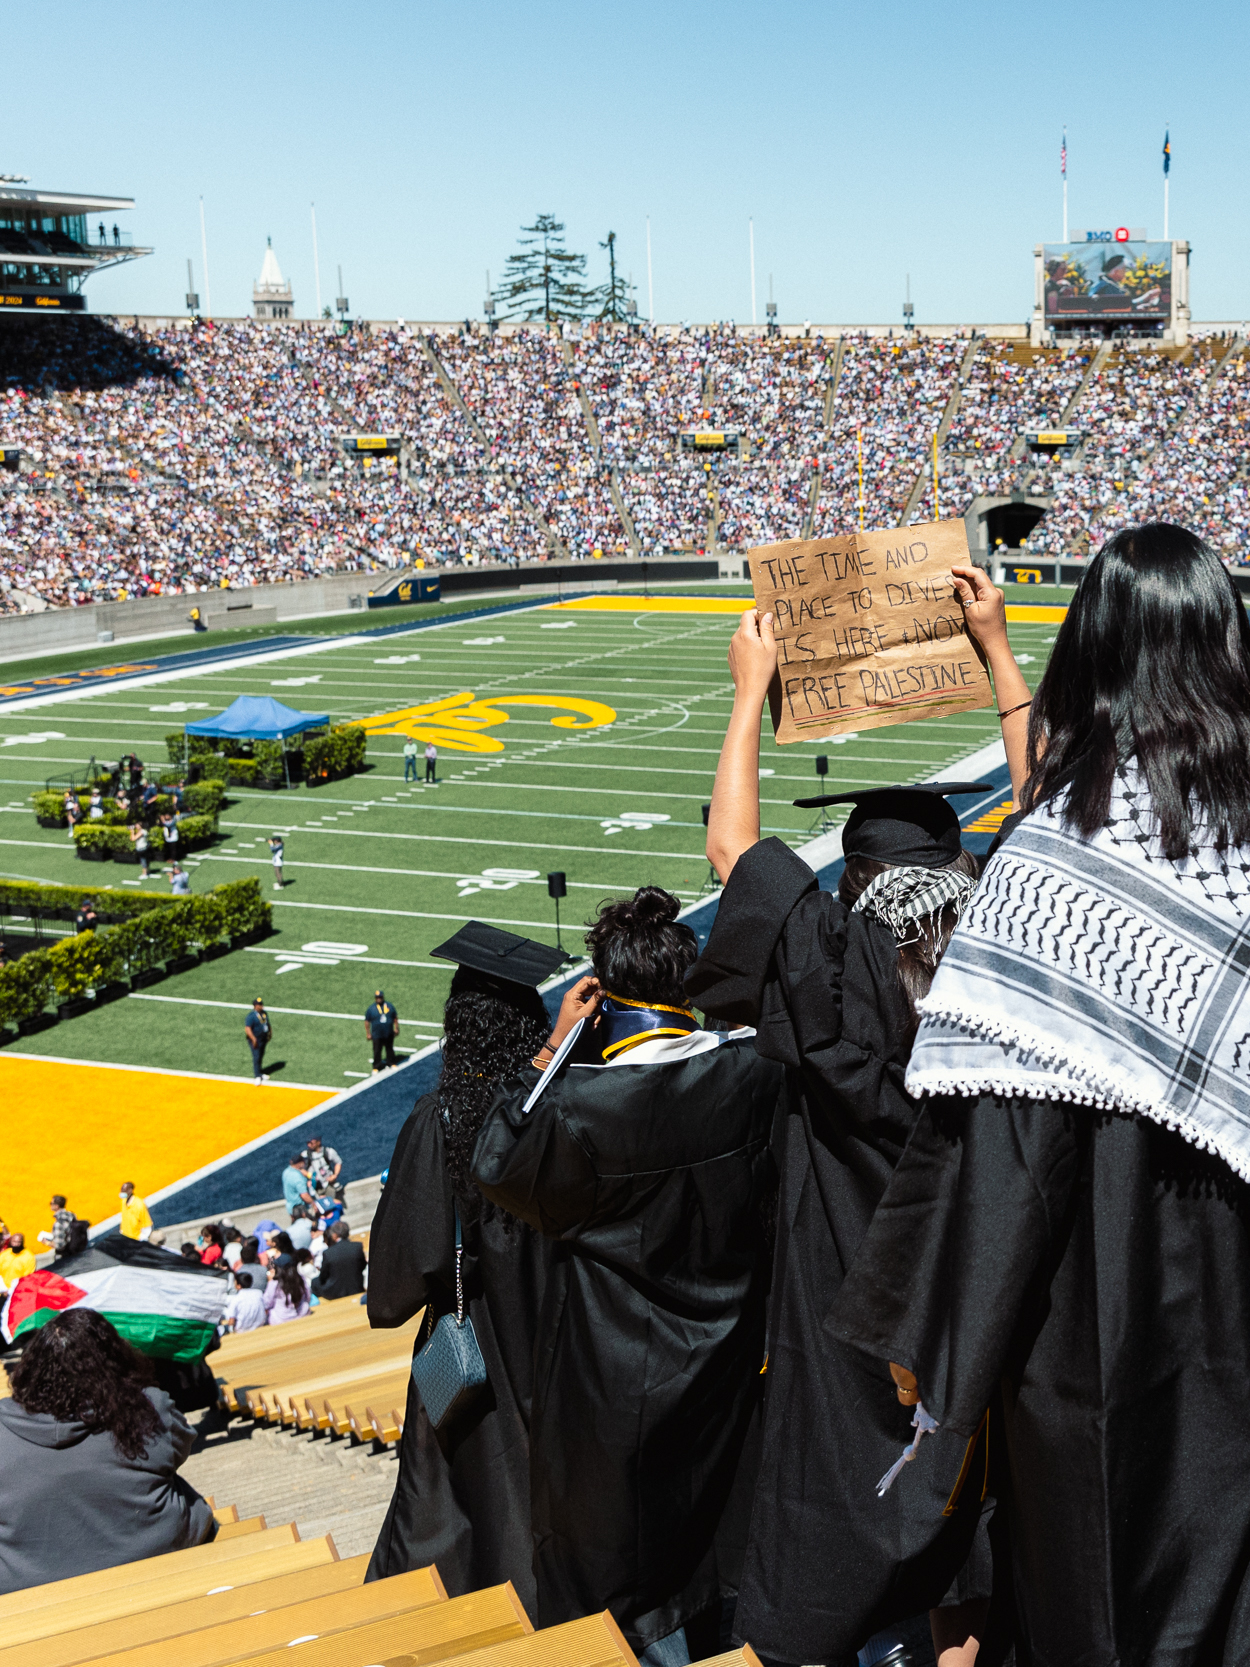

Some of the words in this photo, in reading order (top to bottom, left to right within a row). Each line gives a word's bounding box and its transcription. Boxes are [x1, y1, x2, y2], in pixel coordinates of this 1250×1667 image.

[761, 556, 810, 591] THE
[815, 549, 876, 581] TIME
[886, 542, 928, 571] AND
[774, 596, 836, 630] PLACE
[848, 587, 873, 614] TO
[776, 632, 817, 666] IS
[833, 624, 891, 660] HERE
[785, 673, 850, 719] FREE
[859, 661, 977, 707] PALESTINE
